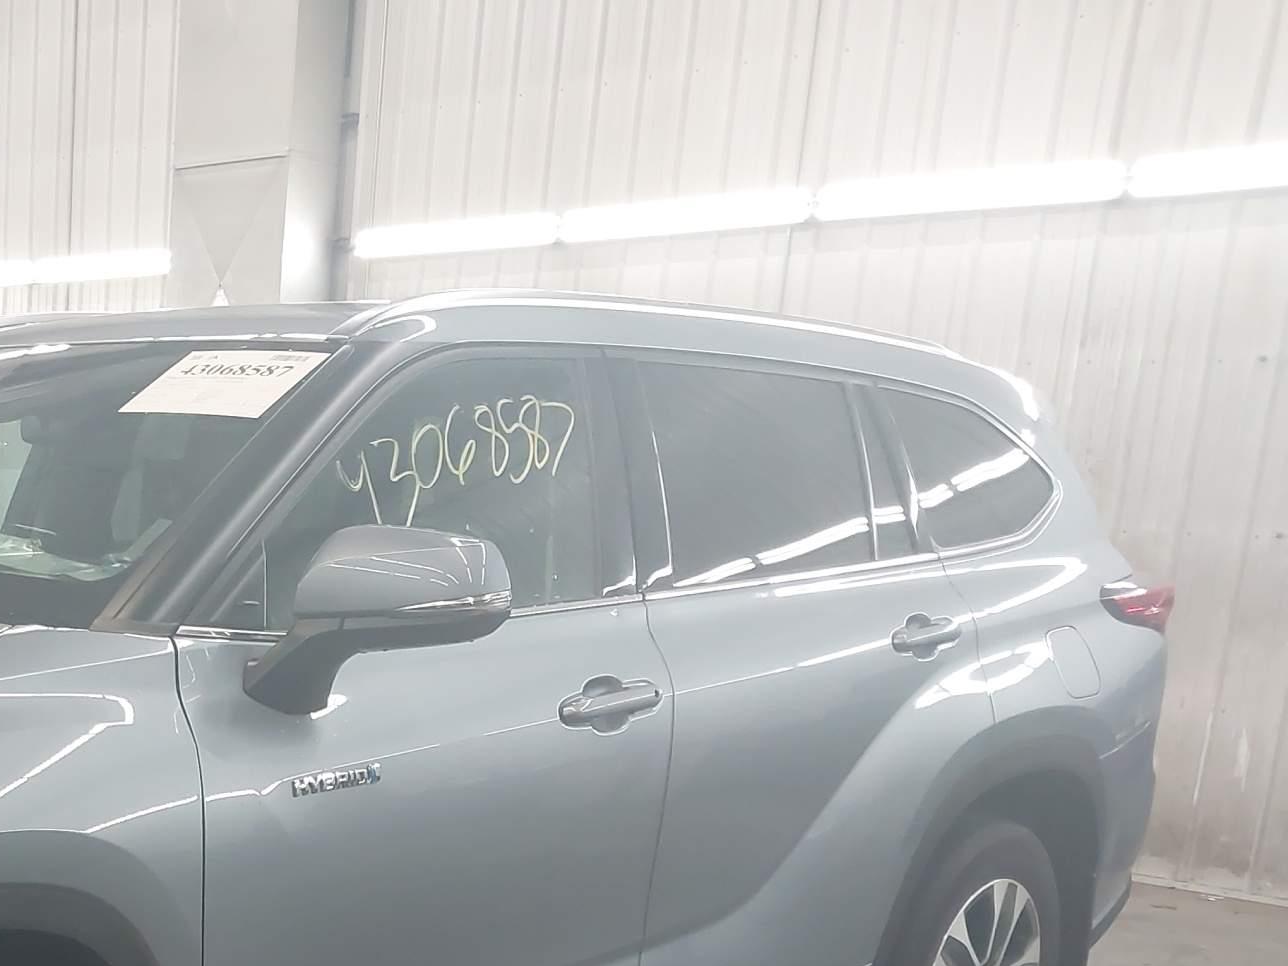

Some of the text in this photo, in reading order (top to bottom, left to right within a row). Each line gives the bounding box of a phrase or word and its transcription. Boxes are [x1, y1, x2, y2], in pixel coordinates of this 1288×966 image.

[179, 363, 295, 378] 43068587
[335, 394, 574, 527] 43068587
[292, 768, 368, 799] HYBRID
